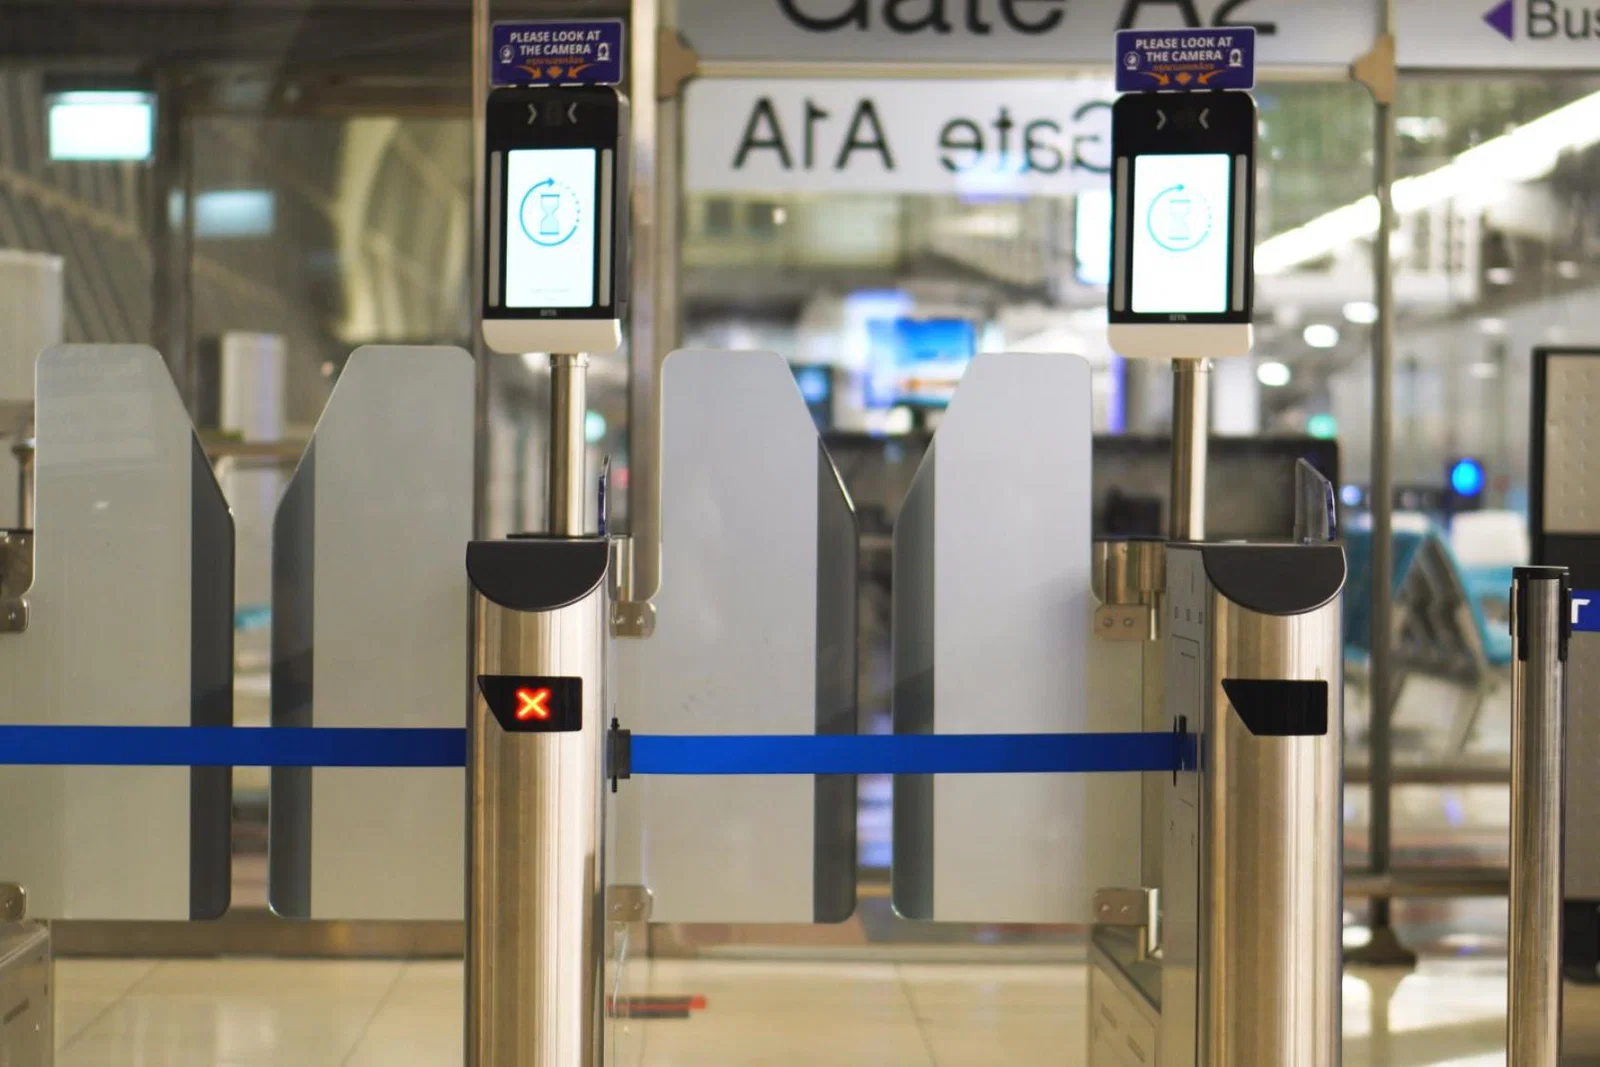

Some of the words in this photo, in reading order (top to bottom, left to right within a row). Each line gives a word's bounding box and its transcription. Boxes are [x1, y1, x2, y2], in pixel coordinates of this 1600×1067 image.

[510, 31, 549, 43] PLEASE
[552, 31, 584, 42] LOOK
[587, 30, 602, 41] AT
[1135, 38, 1178, 49] PLEASE
[1181, 37, 1215, 48] LOOK
[1217, 36, 1233, 47] AT
[520, 45, 540, 56] THE
[543, 44, 591, 55] CAMERA
[1145, 51, 1168, 62] THE
[1171, 50, 1223, 61] CAMERA
